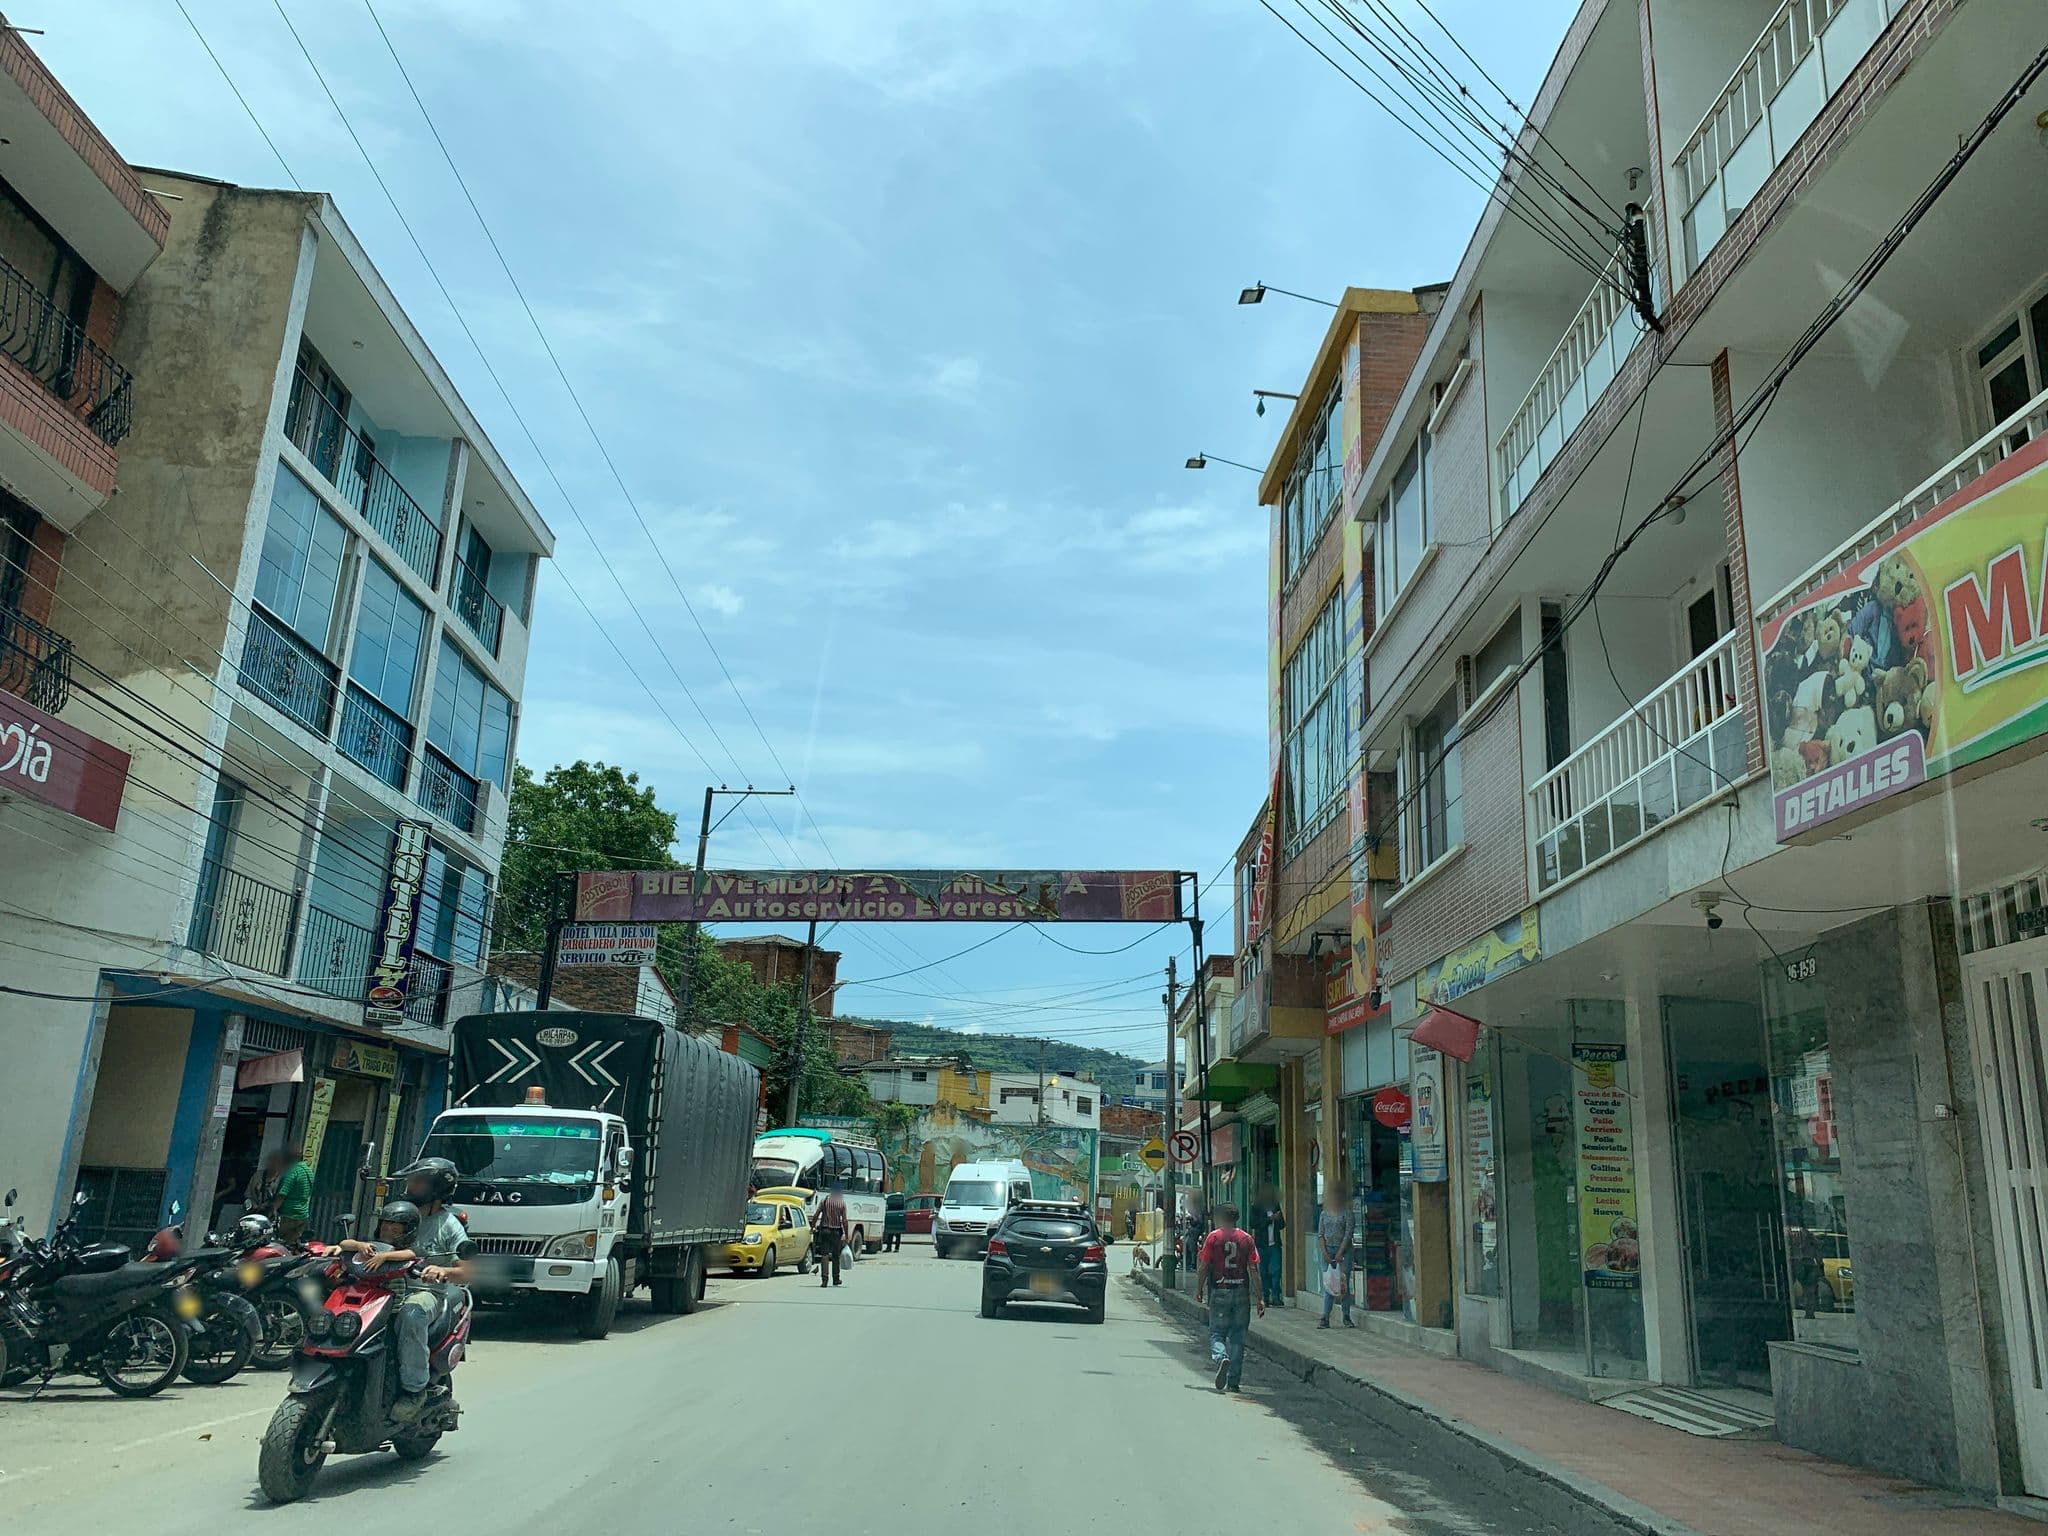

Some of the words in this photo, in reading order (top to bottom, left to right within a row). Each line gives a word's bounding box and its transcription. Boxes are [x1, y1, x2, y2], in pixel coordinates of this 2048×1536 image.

[1944, 528, 2048, 682] M
[1784, 744, 1912, 831] DETALLES
[380, 823, 428, 969] HOTEL
[562, 927, 591, 939] HOTEL
[594, 926, 617, 938] VILLA
[621, 926, 639, 938] DEL
[640, 926, 655, 938] SOL
[619, 938, 655, 949] PRIVADO
[559, 952, 606, 963] SERVICIO
[1583, 1098, 1610, 1106] Carne
[1611, 1099, 1621, 1107] de
[1593, 1135, 1614, 1143] Pollo
[1590, 1164, 1621, 1172] Gallina
[1590, 1174, 1623, 1182] Pescado
[1584, 1185, 1630, 1193] Camarones
[473, 1191, 522, 1203] JAC
[1595, 1196, 1620, 1205] Leche
[1593, 1207, 1624, 1216] Huevos
[1224, 1241, 1238, 1269] 2
